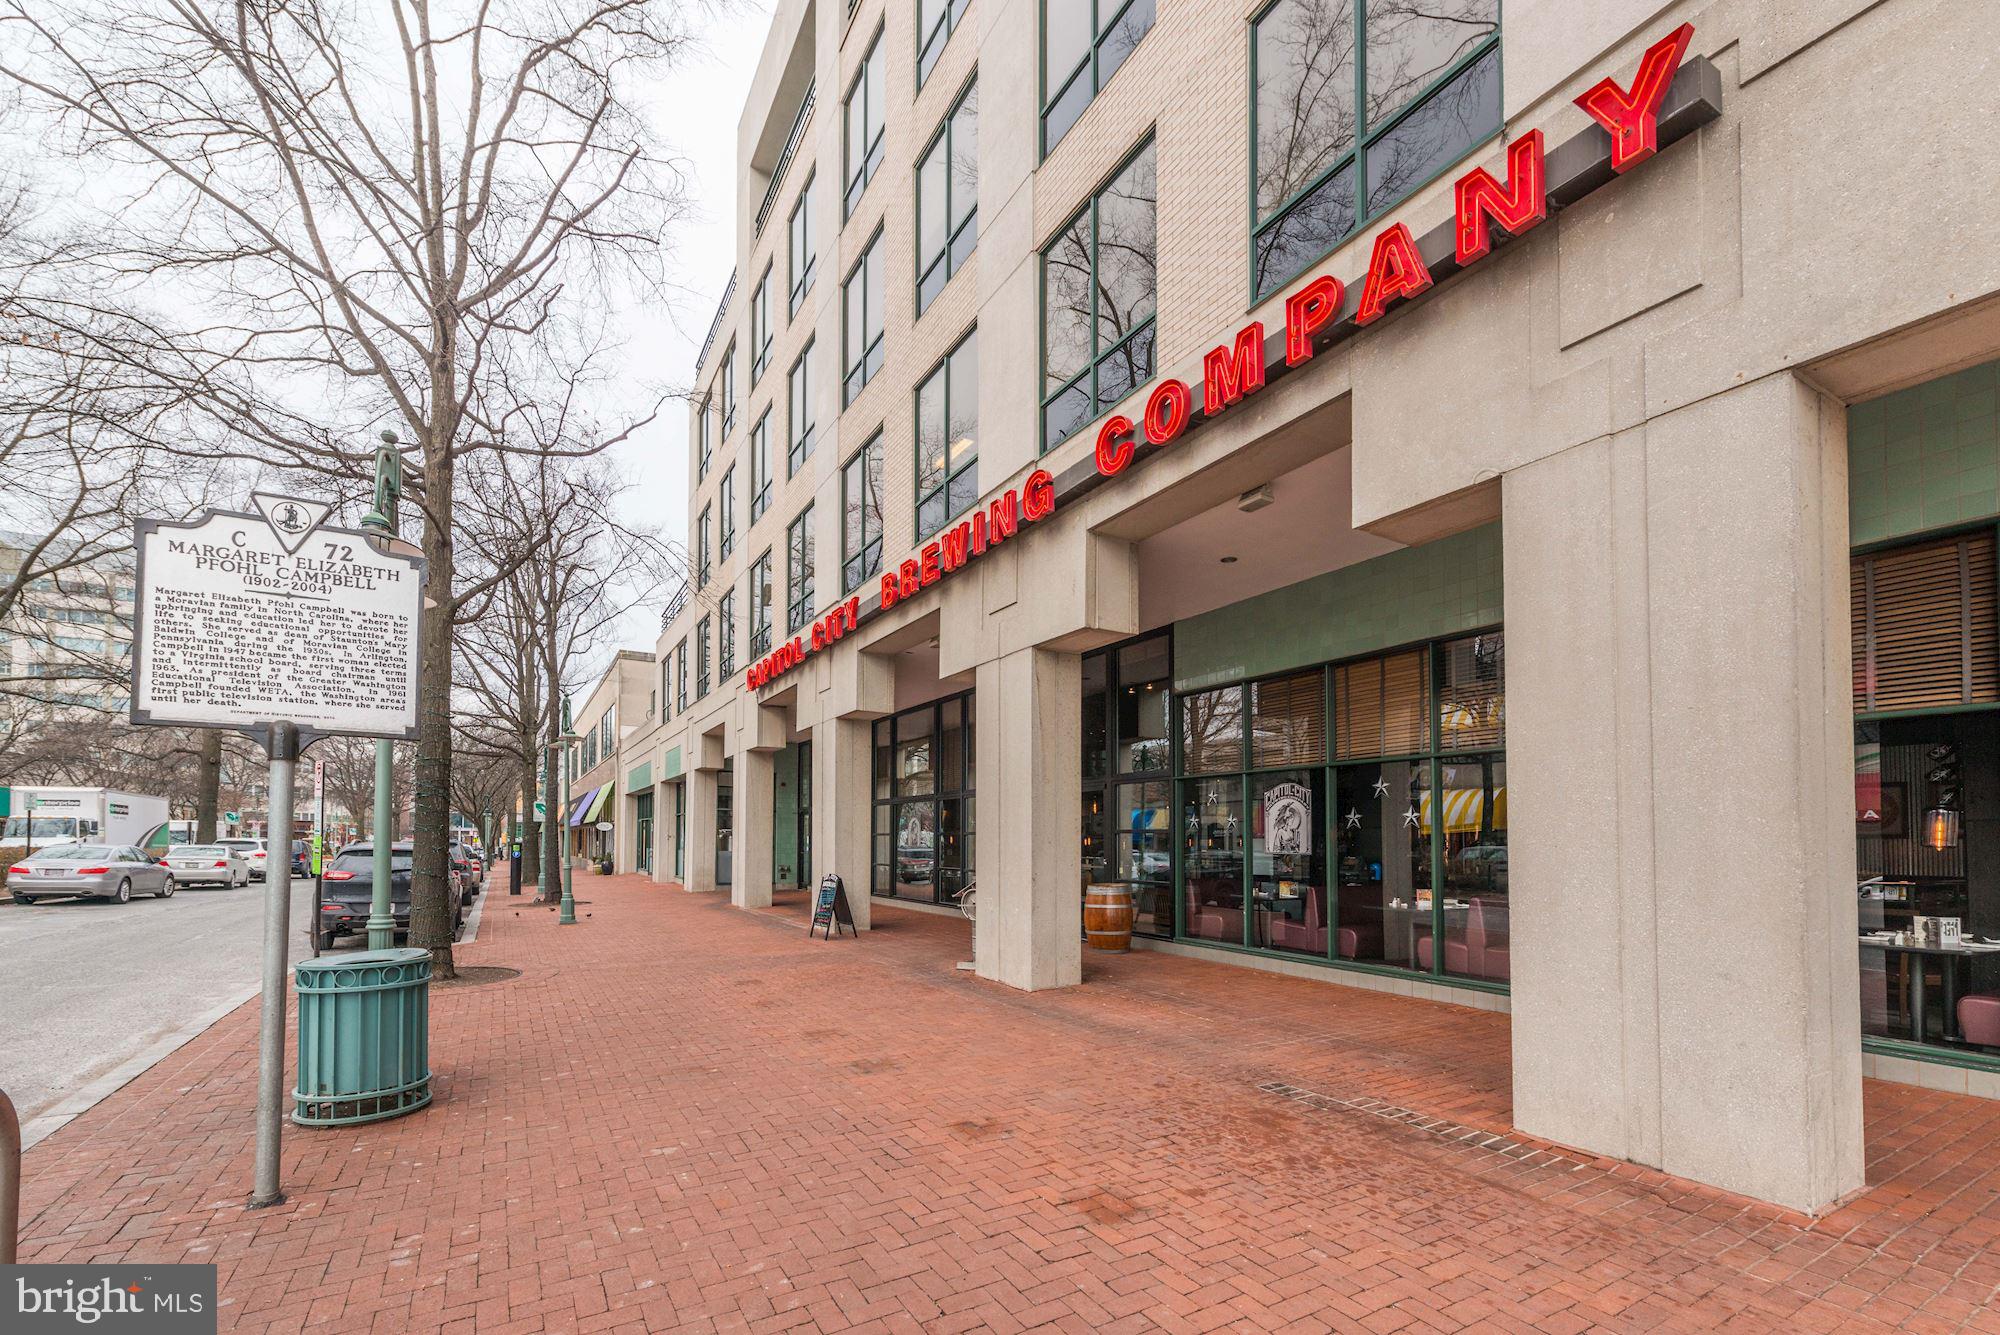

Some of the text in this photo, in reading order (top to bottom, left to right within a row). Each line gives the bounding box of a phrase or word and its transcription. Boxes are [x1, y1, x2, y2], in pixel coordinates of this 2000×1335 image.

[746, 22, 1696, 691] CAPITOL CITY BREWING COMPANY
[168, 539, 400, 581] MARGARET ELIZABETH
[231, 531, 354, 562] C 72
[196, 556, 377, 591] PFOHL CAMPBELL
[243, 575, 332, 595] (1902-2004)
[155, 587, 205, 600] Margaret
[211, 593, 261, 605] Elizabeth
[267, 599, 294, 608] Pfohl
[299, 603, 345, 614] Campbell
[372, 611, 394, 620] born
[166, 595, 215, 607] Moravian
[219, 601, 253, 612] family
[274, 607, 304, 617] North
[361, 618, 389, 626] where
[154, 603, 213, 616] upbringing
[243, 612, 294, 623] education
[298, 617, 314, 625] led
[320, 619, 336, 627] her
[357, 623, 388, 633] devote
[393, 627, 408, 635] her
[155, 610, 174, 618] life
[202, 616, 242, 626] seeking
[250, 620, 309, 632] educational
[318, 628, 384, 640] opportunities
[153, 632, 224, 646] Pennsylvania
[234, 640, 268, 651] during
[276, 644, 293, 652] the
[154, 625, 195, 635] Baldwin
[206, 630, 246, 641] College
[303, 639, 348, 650] Moravian
[356, 644, 391, 655] College
[202, 622, 221, 630] She
[227, 626, 261, 634] served
[284, 630, 308, 639] dean
[384, 640, 408, 650] Mary
[153, 640, 203, 652] Campbell
[209, 645, 219, 653] in
[223, 646, 246, 655] 1947
[248, 649, 287, 659] became
[311, 655, 334, 663] first
[373, 660, 407, 669] elected
[181, 650, 225, 661] Virginia
[229, 655, 263, 664] school
[309, 663, 345, 672] serving
[350, 666, 375, 674] three
[183, 658, 261, 671] intermittently
[292, 667, 322, 676] board
[331, 671, 375, 681] chairman
[189, 666, 203, 674] As
[211, 670, 261, 678] president
[286, 674, 303, 682] the
[309, 676, 346, 685] Greater
[352, 679, 406, 690] Washington
[151, 679, 202, 690] Campbell
[208, 683, 251, 693] founded
[300, 690, 317, 698] the
[321, 691, 375, 702] Washington
[151, 686, 178, 695] first
[182, 689, 215, 699] public
[220, 691, 272, 702] television
[324, 699, 352, 707] where
[355, 701, 371, 709] she
[152, 671, 215, 682] Educational
[228, 677, 282, 688] Television
[386, 689, 406, 697] 1961
[183, 696, 201, 704] her
